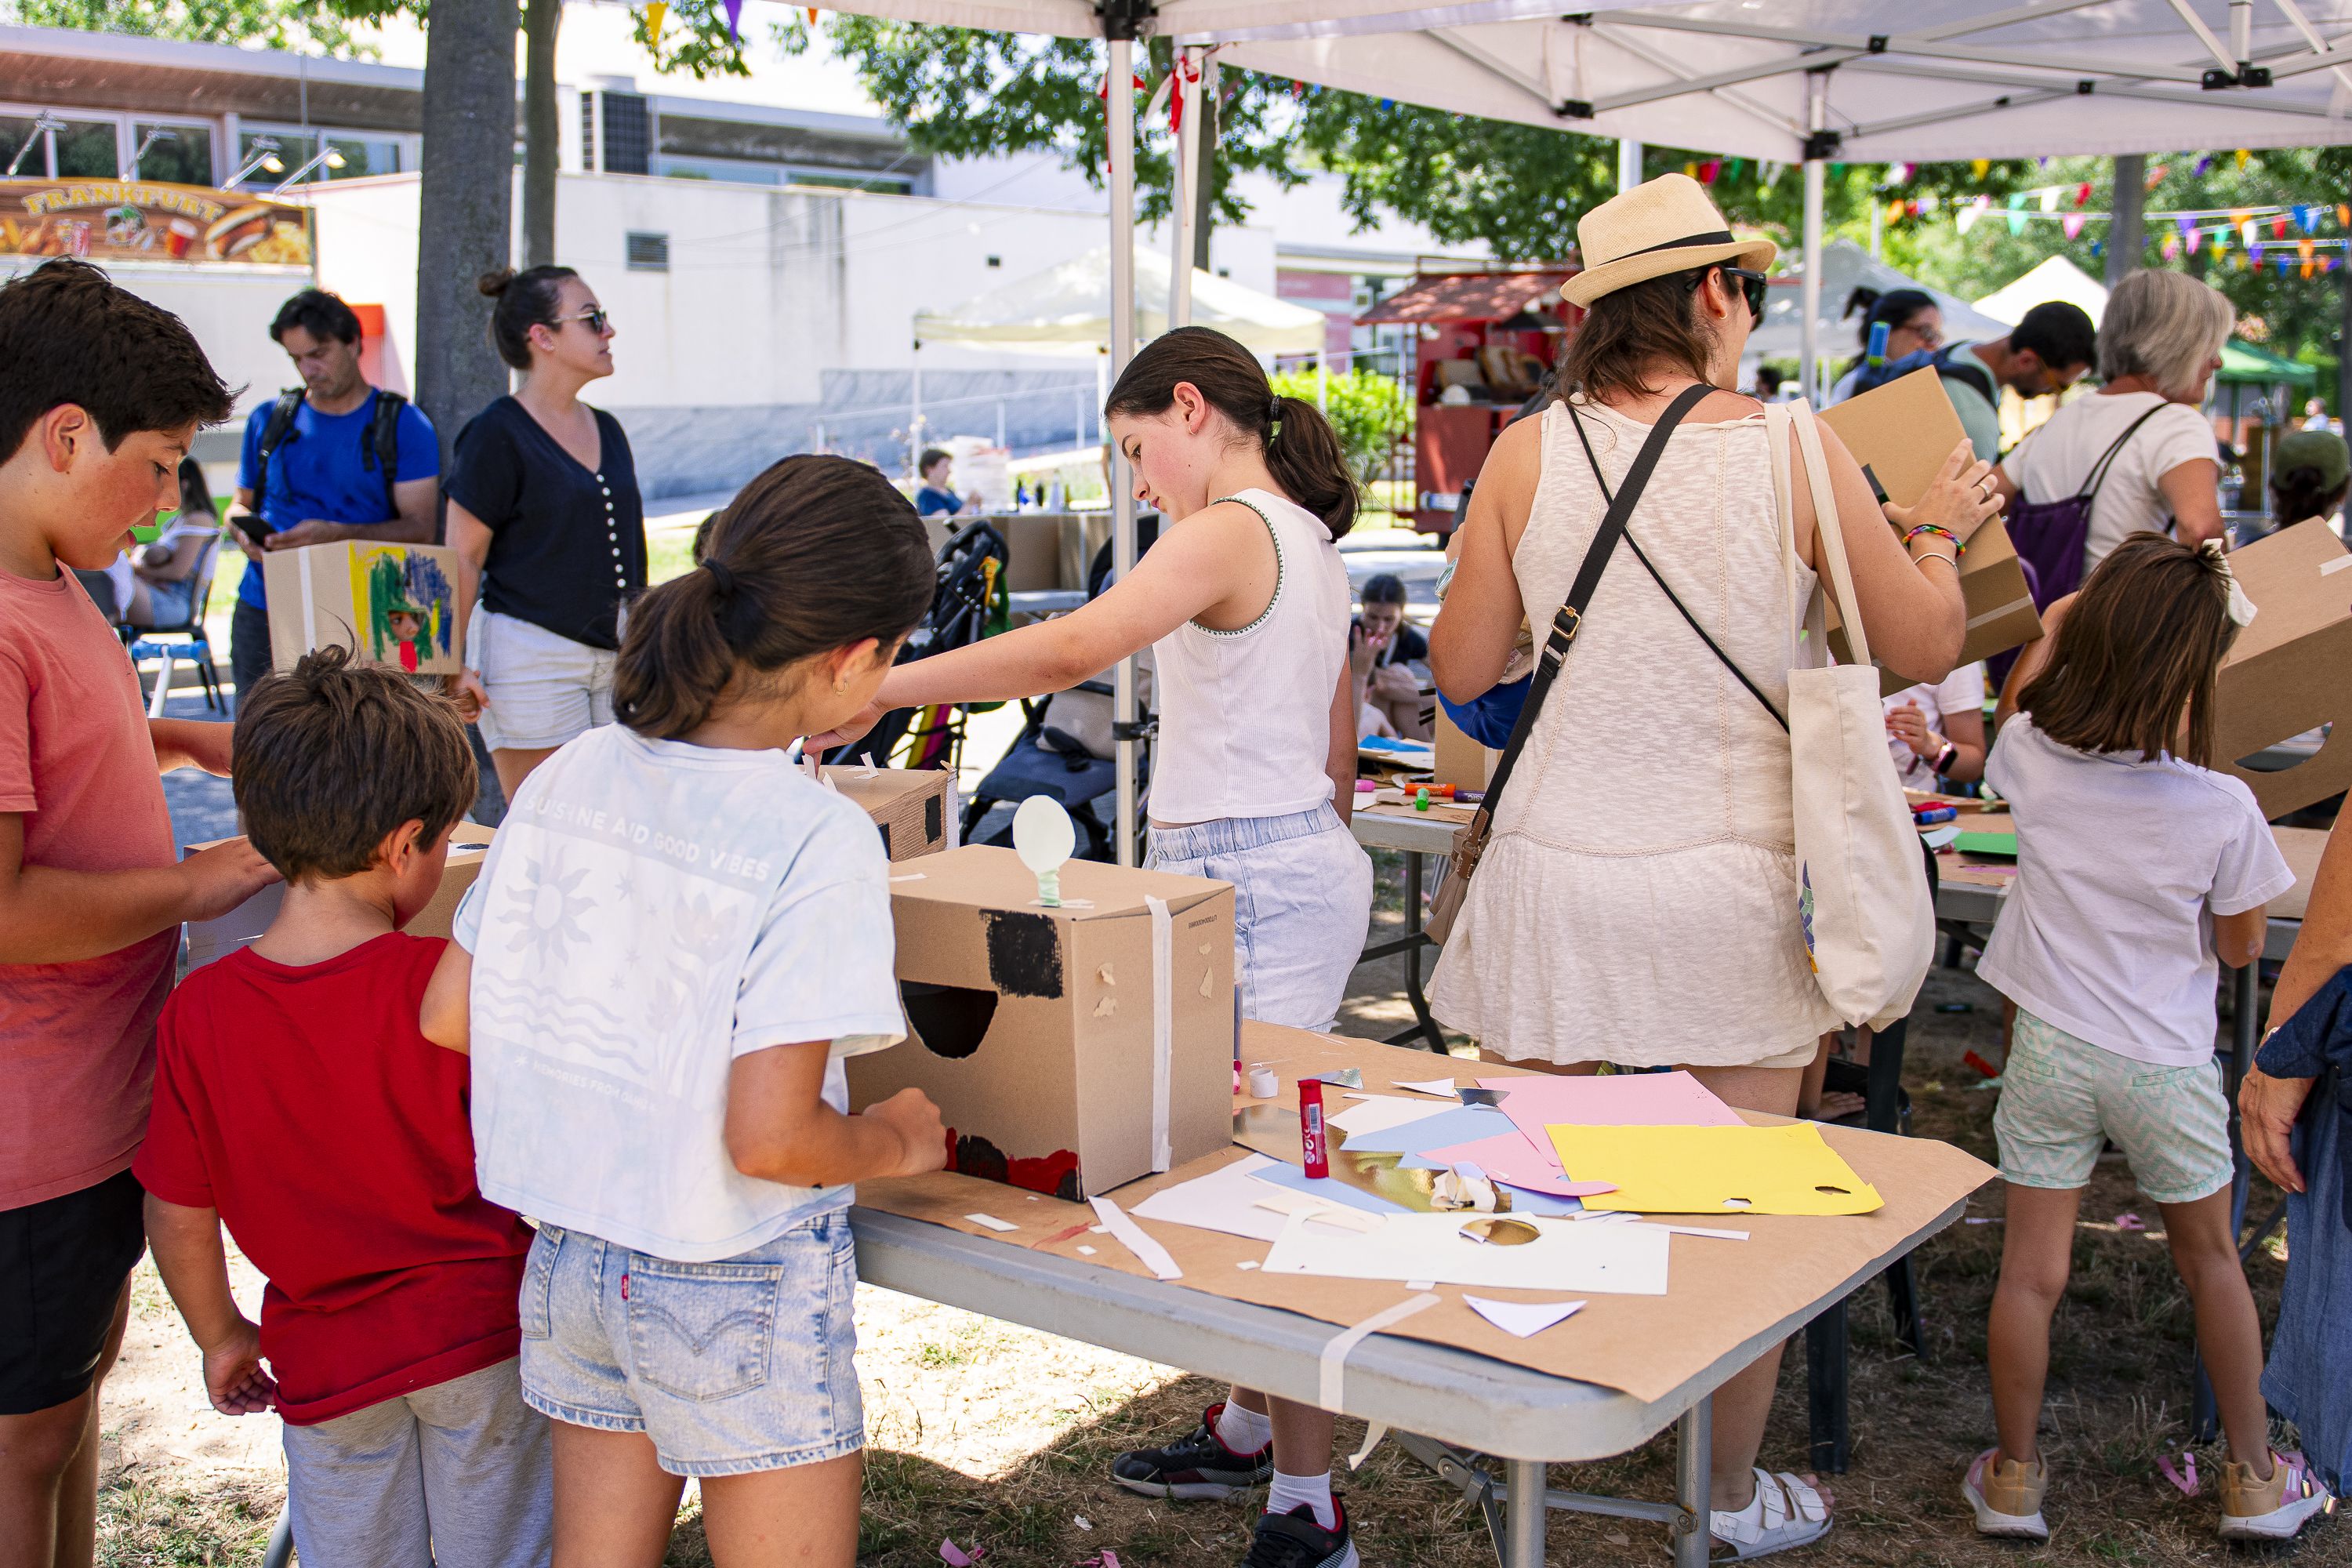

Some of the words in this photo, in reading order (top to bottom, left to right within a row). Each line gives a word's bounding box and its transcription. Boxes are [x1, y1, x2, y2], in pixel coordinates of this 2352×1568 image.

[22, 184, 226, 223] FRANKFURT
[1468, 793, 1485, 802] ASIC
[654, 831, 700, 863] GOOD
